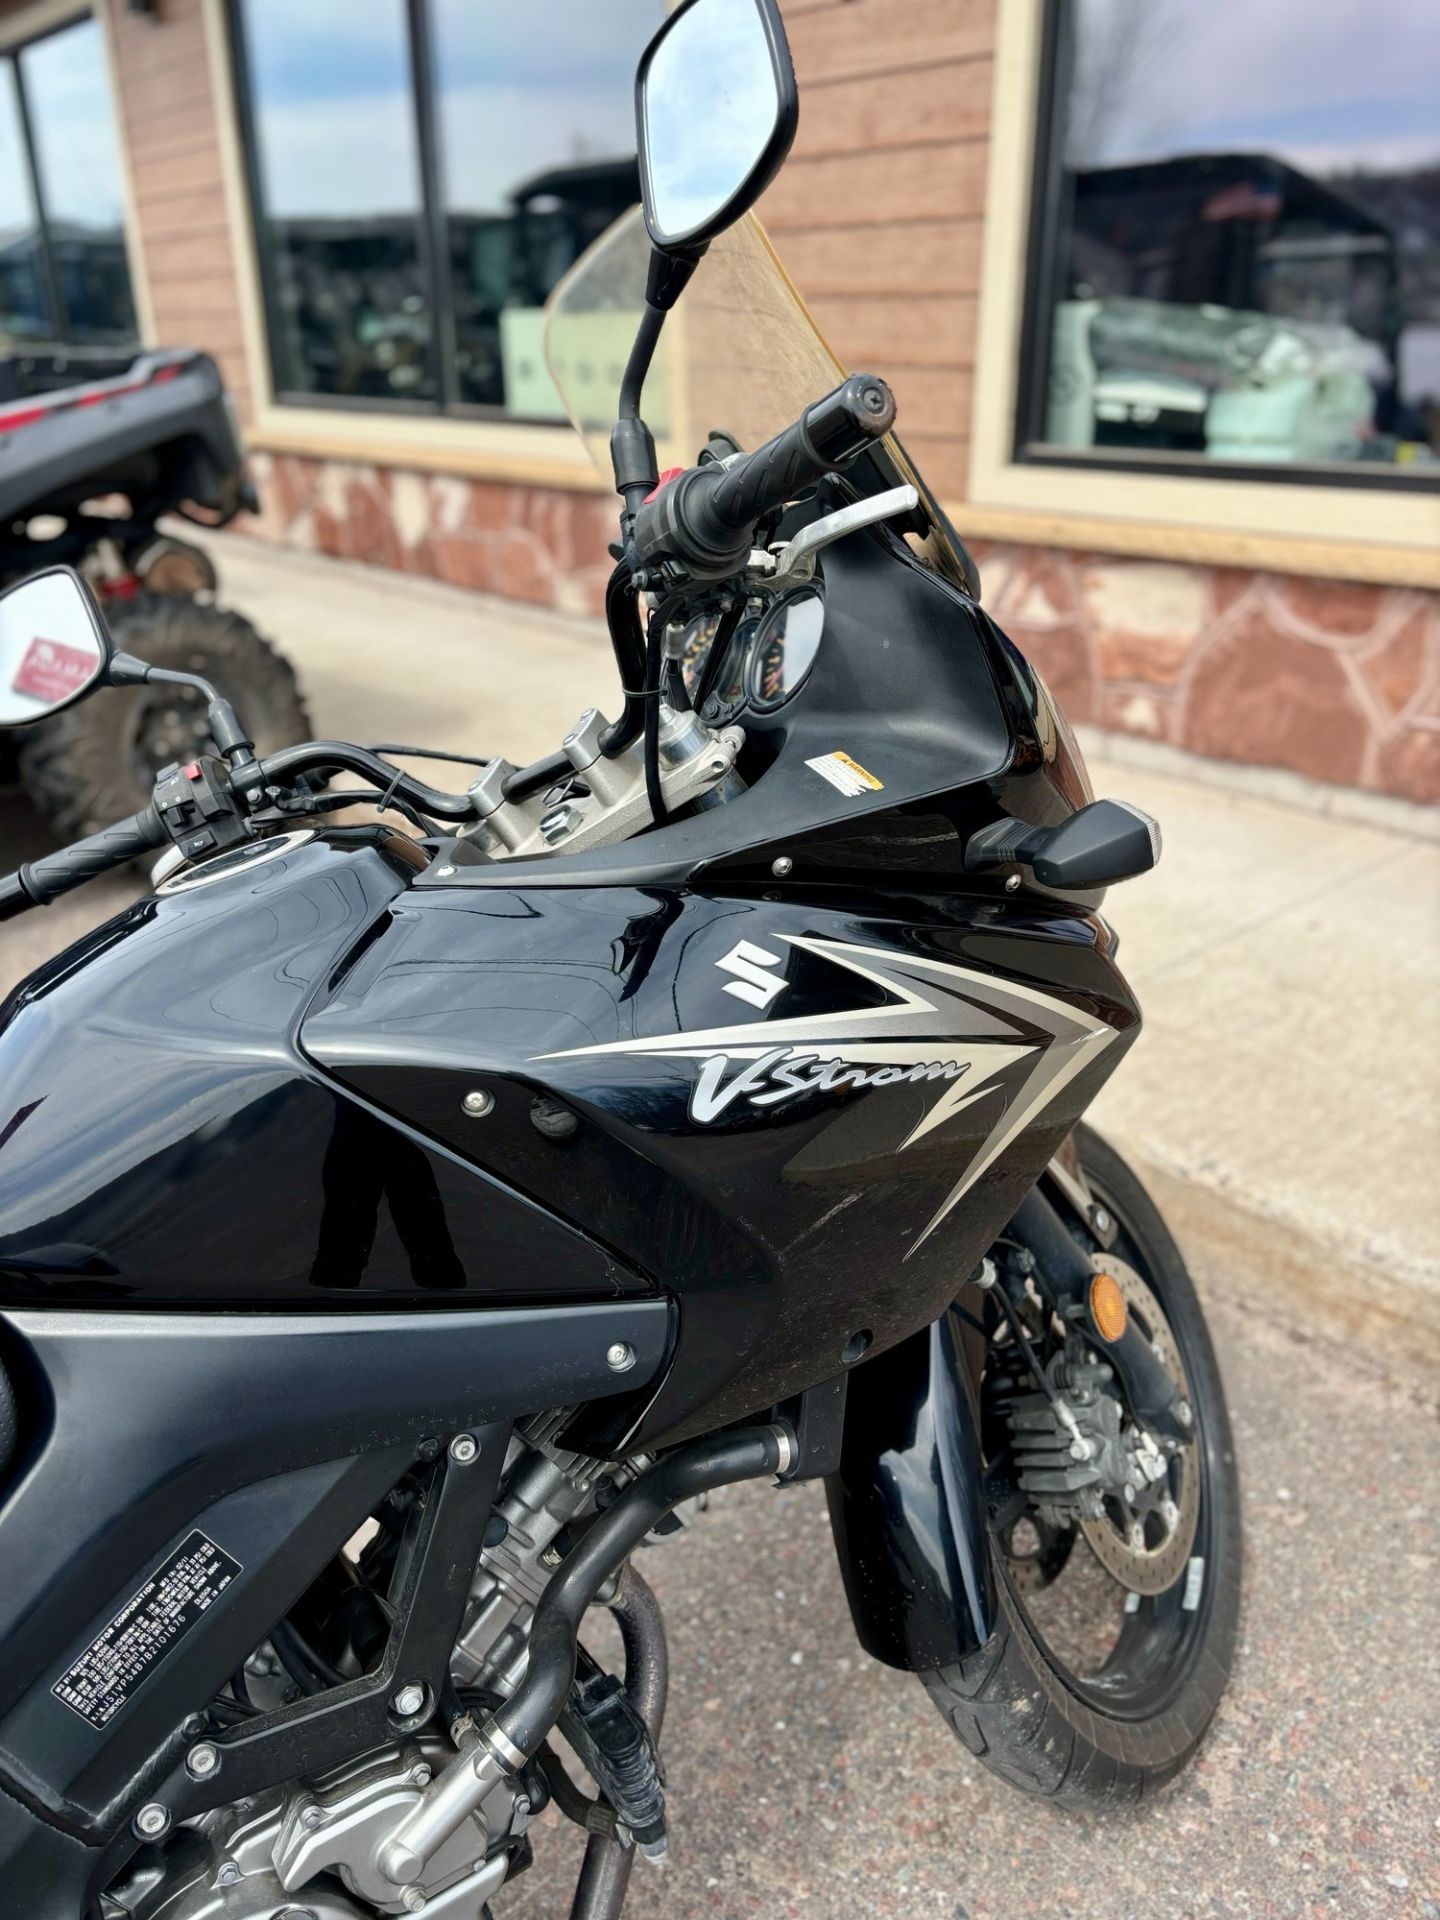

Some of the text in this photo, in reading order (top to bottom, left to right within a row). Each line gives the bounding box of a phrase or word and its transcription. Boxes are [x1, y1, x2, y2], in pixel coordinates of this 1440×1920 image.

[174, 1555, 189, 1570] 02/11
[199, 1596, 212, 1610] MADE
[217, 1574, 231, 1590] JAPAN
[69, 1651, 93, 1676] SUZUKI
[91, 1627, 115, 1651] MOTOR
[113, 1581, 155, 1627] CORPORATION
[77, 1698, 89, 1710] THIS
[87, 1679, 105, 1699] VEHICLE
[103, 1658, 124, 1680] CONFORMS
[136, 1617, 161, 1643] APPLICABLE
[158, 1598, 177, 1618] FEDERAL
[175, 1584, 190, 1599] MOTOR
[188, 1565, 206, 1584] VEHICLE
[82, 1697, 99, 1715] SAFETY
[97, 1674, 119, 1698] STANDARDS
[123, 1651, 140, 1668] EFFECT
[152, 1623, 164, 1636] DATE
[168, 1589, 195, 1618] MANUFACTURE
[193, 1575, 207, 1590] SHOWN
[100, 1693, 126, 1721] MOTORCYCLE
